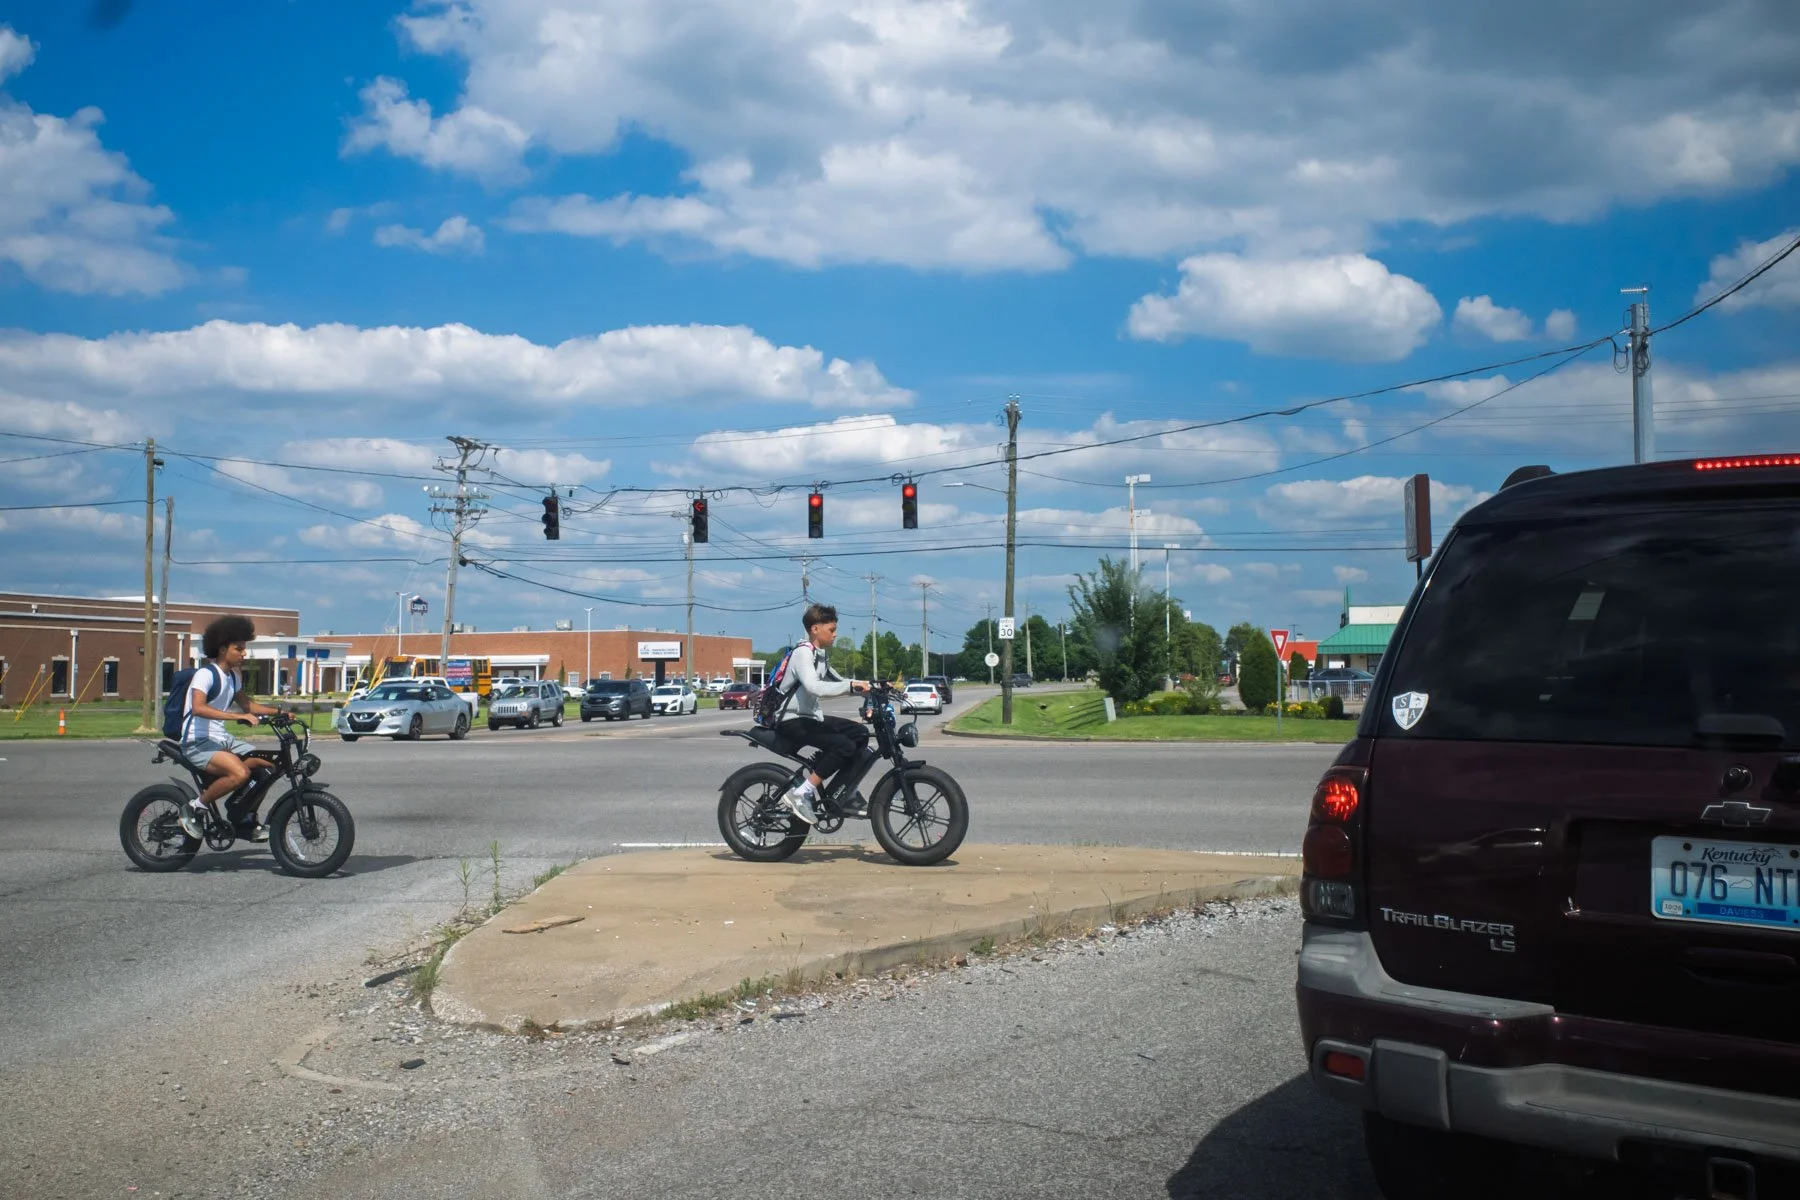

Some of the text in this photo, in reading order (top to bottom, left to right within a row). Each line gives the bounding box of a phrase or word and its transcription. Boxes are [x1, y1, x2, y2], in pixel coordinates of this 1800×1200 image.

[1001, 628, 1013, 636] 30
[1399, 697, 1407, 708] S
[1409, 709, 1416, 718] A
[1702, 847, 1771, 866] Kentucky
[1670, 861, 1800, 908] 076 NT
[1719, 906, 1765, 918] DAVIESS
[1489, 938, 1516, 953] LS
